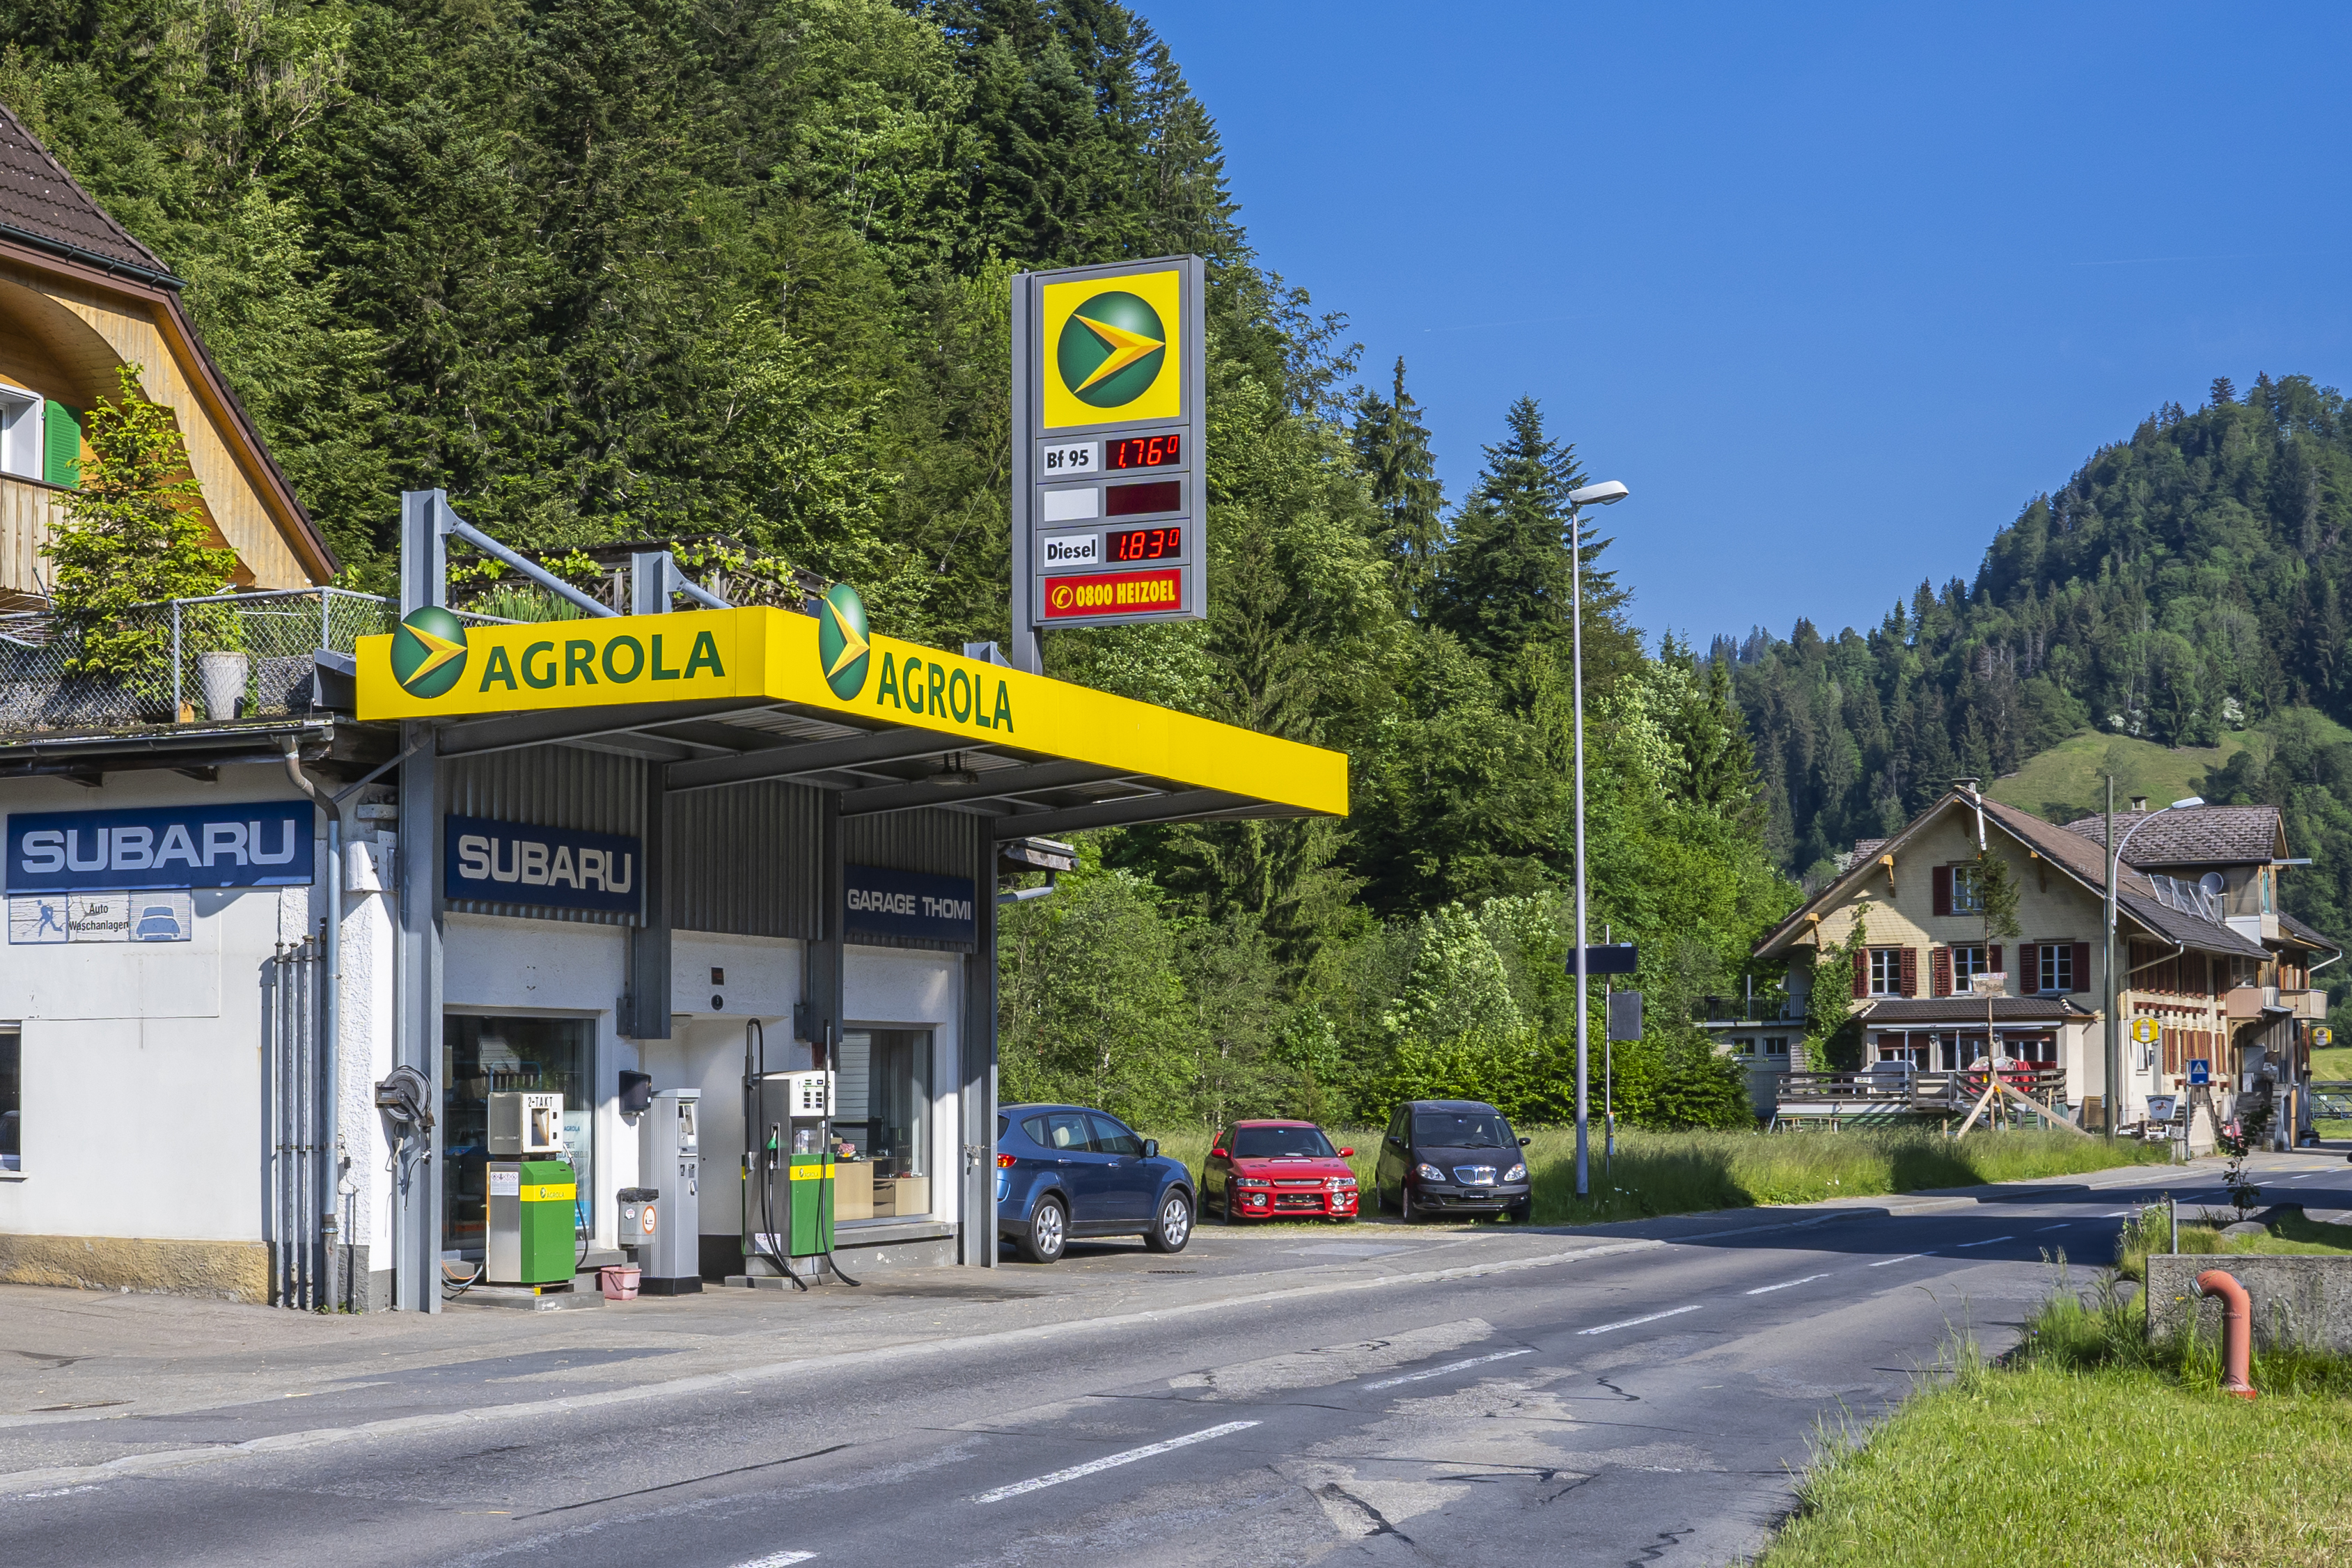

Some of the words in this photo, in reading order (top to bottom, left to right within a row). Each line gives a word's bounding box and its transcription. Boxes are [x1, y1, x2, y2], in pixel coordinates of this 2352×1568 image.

[1046, 450, 1064, 469] Bf
[1069, 449, 1089, 467] 95
[1046, 539, 1097, 561] Diesel
[1075, 583, 1113, 607] 0800
[1116, 580, 1175, 604] HEIZOEL
[478, 630, 726, 693] AGROLA
[877, 652, 1014, 733] AGROLA
[22, 820, 295, 873] SUBARU
[458, 834, 632, 893] SUBARU
[89, 904, 109, 914] Auto
[847, 888, 916, 915] GARAGE
[923, 896, 971, 920] THOMI
[69, 920, 129, 932] Waschanlagen
[528, 1096, 554, 1108] 2-TAKT
